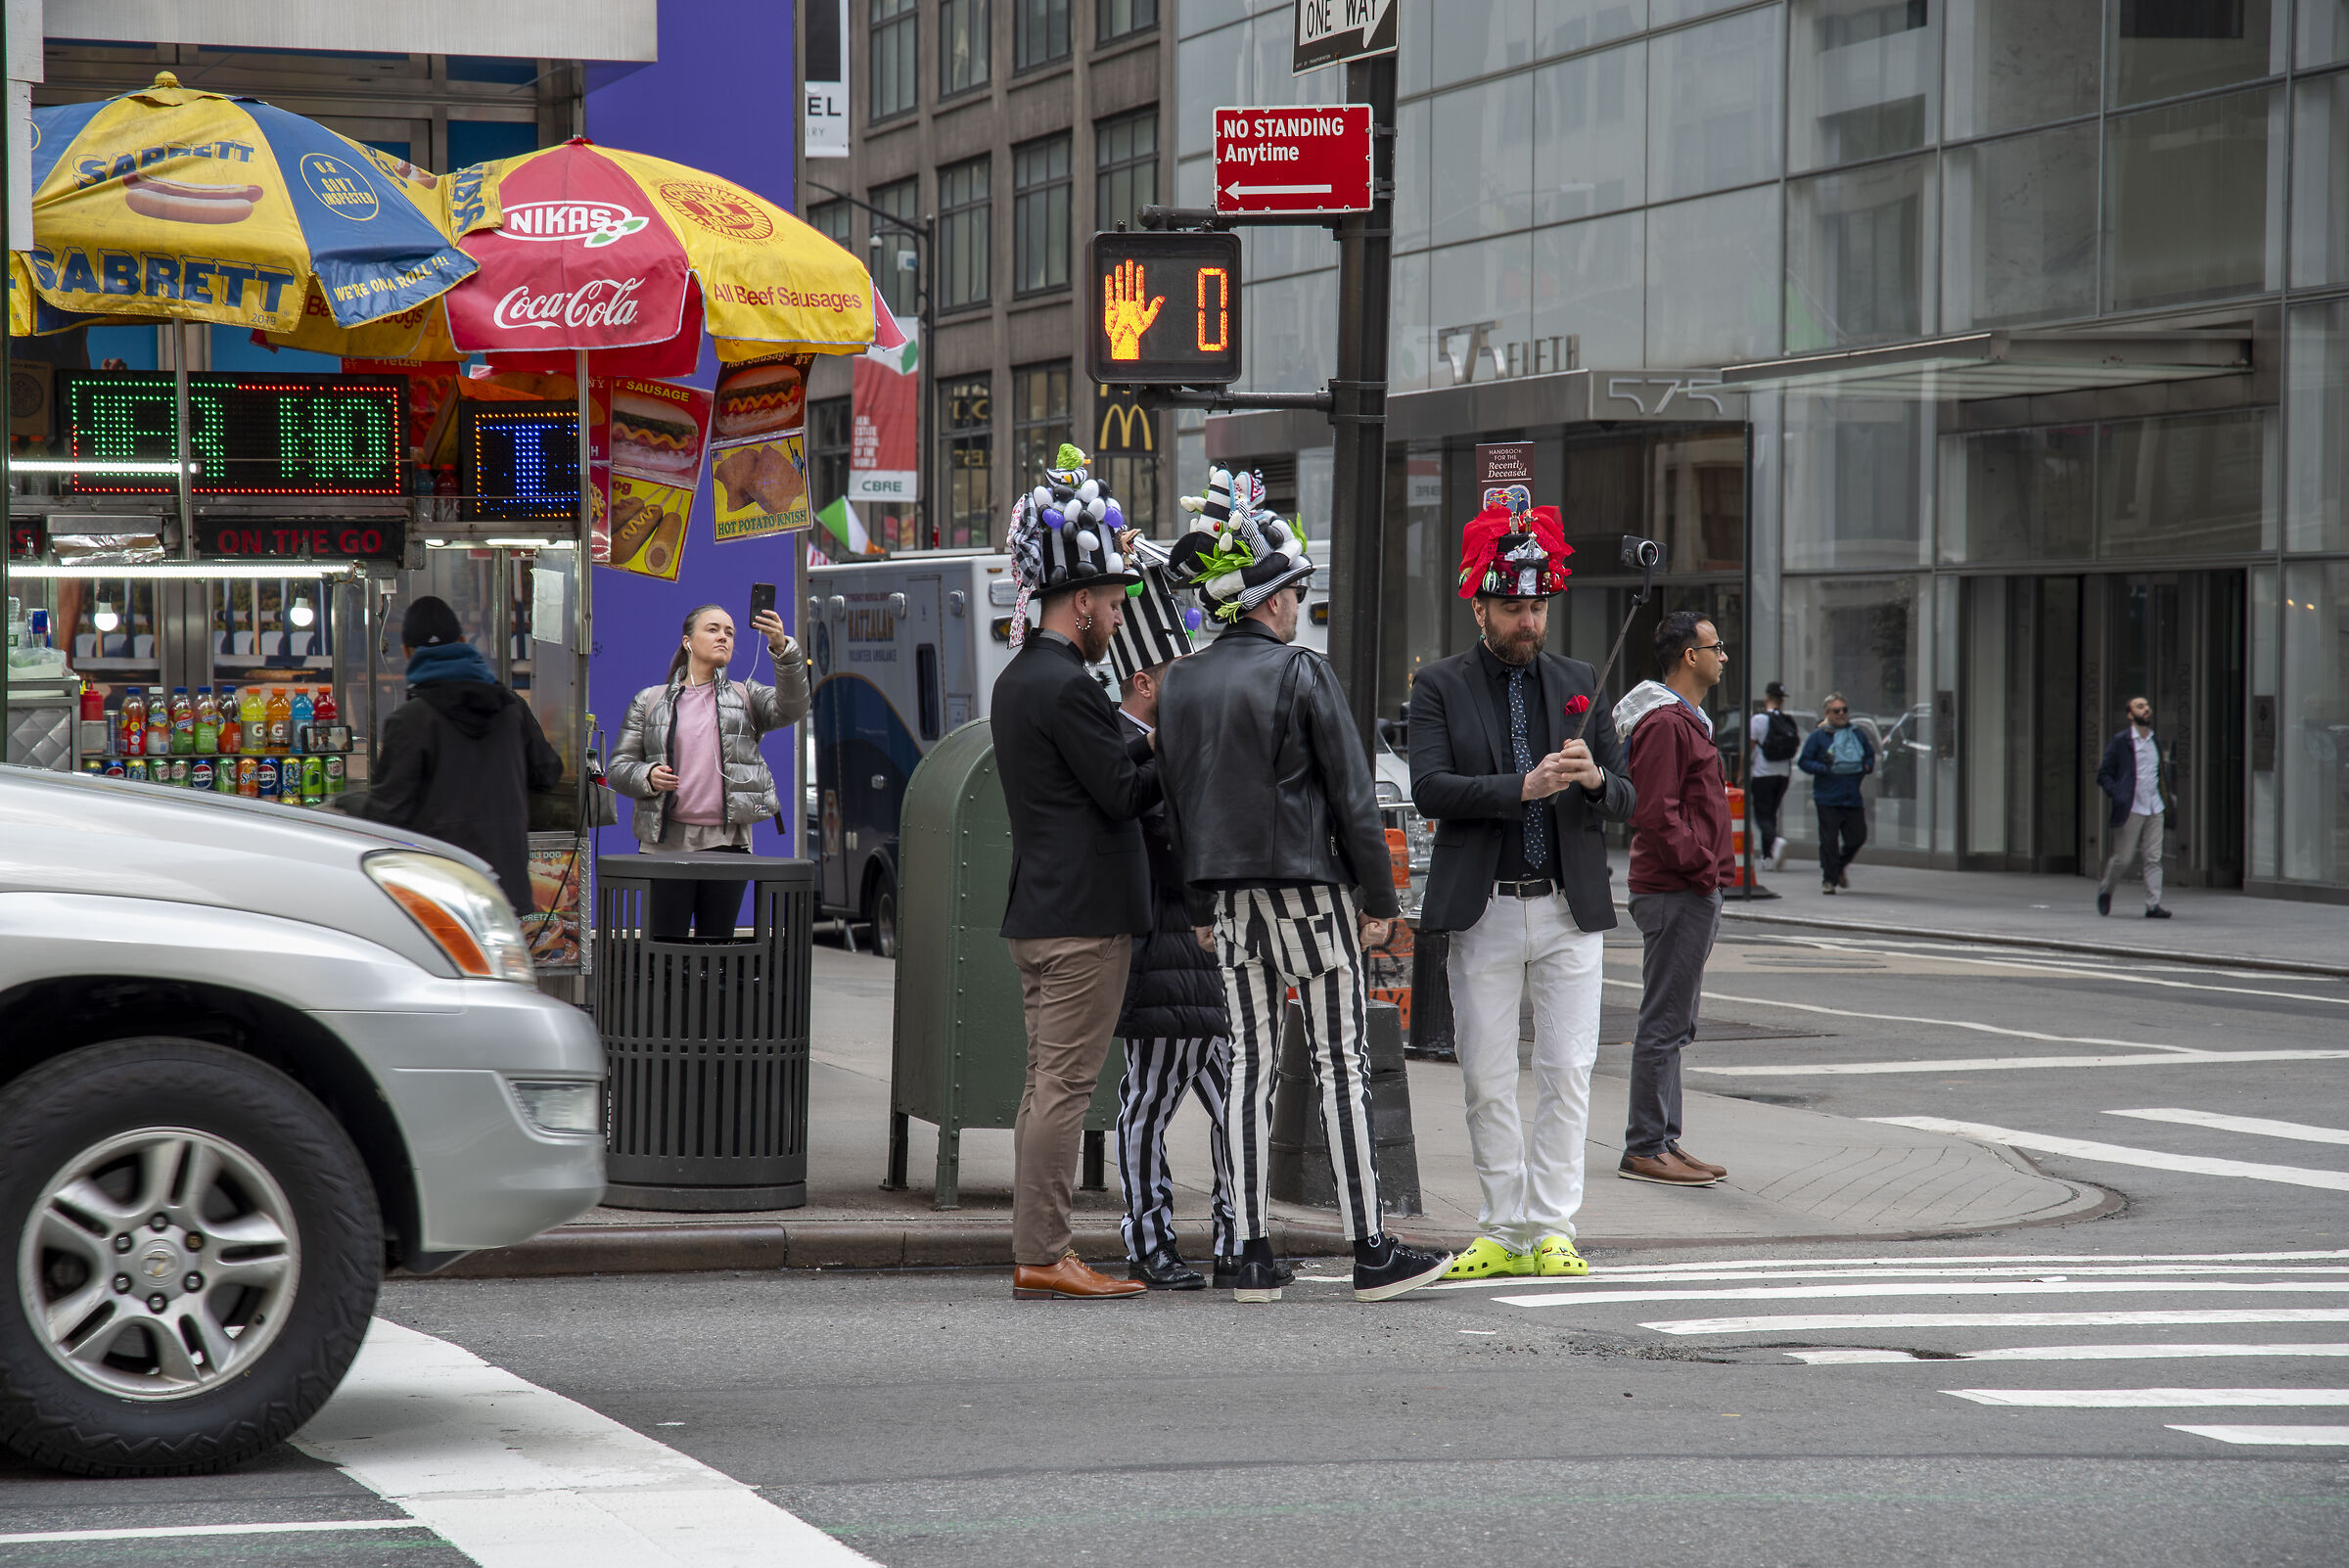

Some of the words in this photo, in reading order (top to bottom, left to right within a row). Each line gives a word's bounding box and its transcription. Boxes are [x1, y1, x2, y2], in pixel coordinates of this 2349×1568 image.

[1307, 0, 1331, 38] ONE
[1223, 118, 1249, 139] NO
[1254, 117, 1345, 138] STANDING
[1224, 142, 1300, 166] Anytime
[313, 161, 339, 173] U.S.
[321, 177, 356, 193] GOV'T
[321, 192, 375, 206] INSPECTED
[510, 207, 612, 234] NIKAS
[29, 245, 294, 313] SABRETT
[334, 282, 370, 301] WE'RE
[395, 264, 432, 289] ROLL
[493, 277, 646, 329] Coca-Cola
[714, 283, 734, 303] All
[734, 285, 774, 306] Beef
[777, 287, 862, 313] Sausages
[1196, 267, 1227, 352] 0
[251, 312, 277, 326] 2019
[1507, 334, 1580, 377] FIFTH
[626, 381, 690, 402] SAUSAGE
[1608, 377, 1724, 415] 575
[1488, 468, 1527, 479] Deceased
[1489, 460, 1524, 470] Recently
[861, 481, 902, 493] CBRE
[718, 521, 736, 535] HOT
[738, 514, 775, 532] POTATO
[776, 509, 807, 527] KNISH
[217, 530, 262, 554] ON
[271, 530, 329, 554] THE
[339, 529, 383, 554] GO
[543, 851, 562, 859] DOG
[523, 912, 559, 922] PRETZEL
